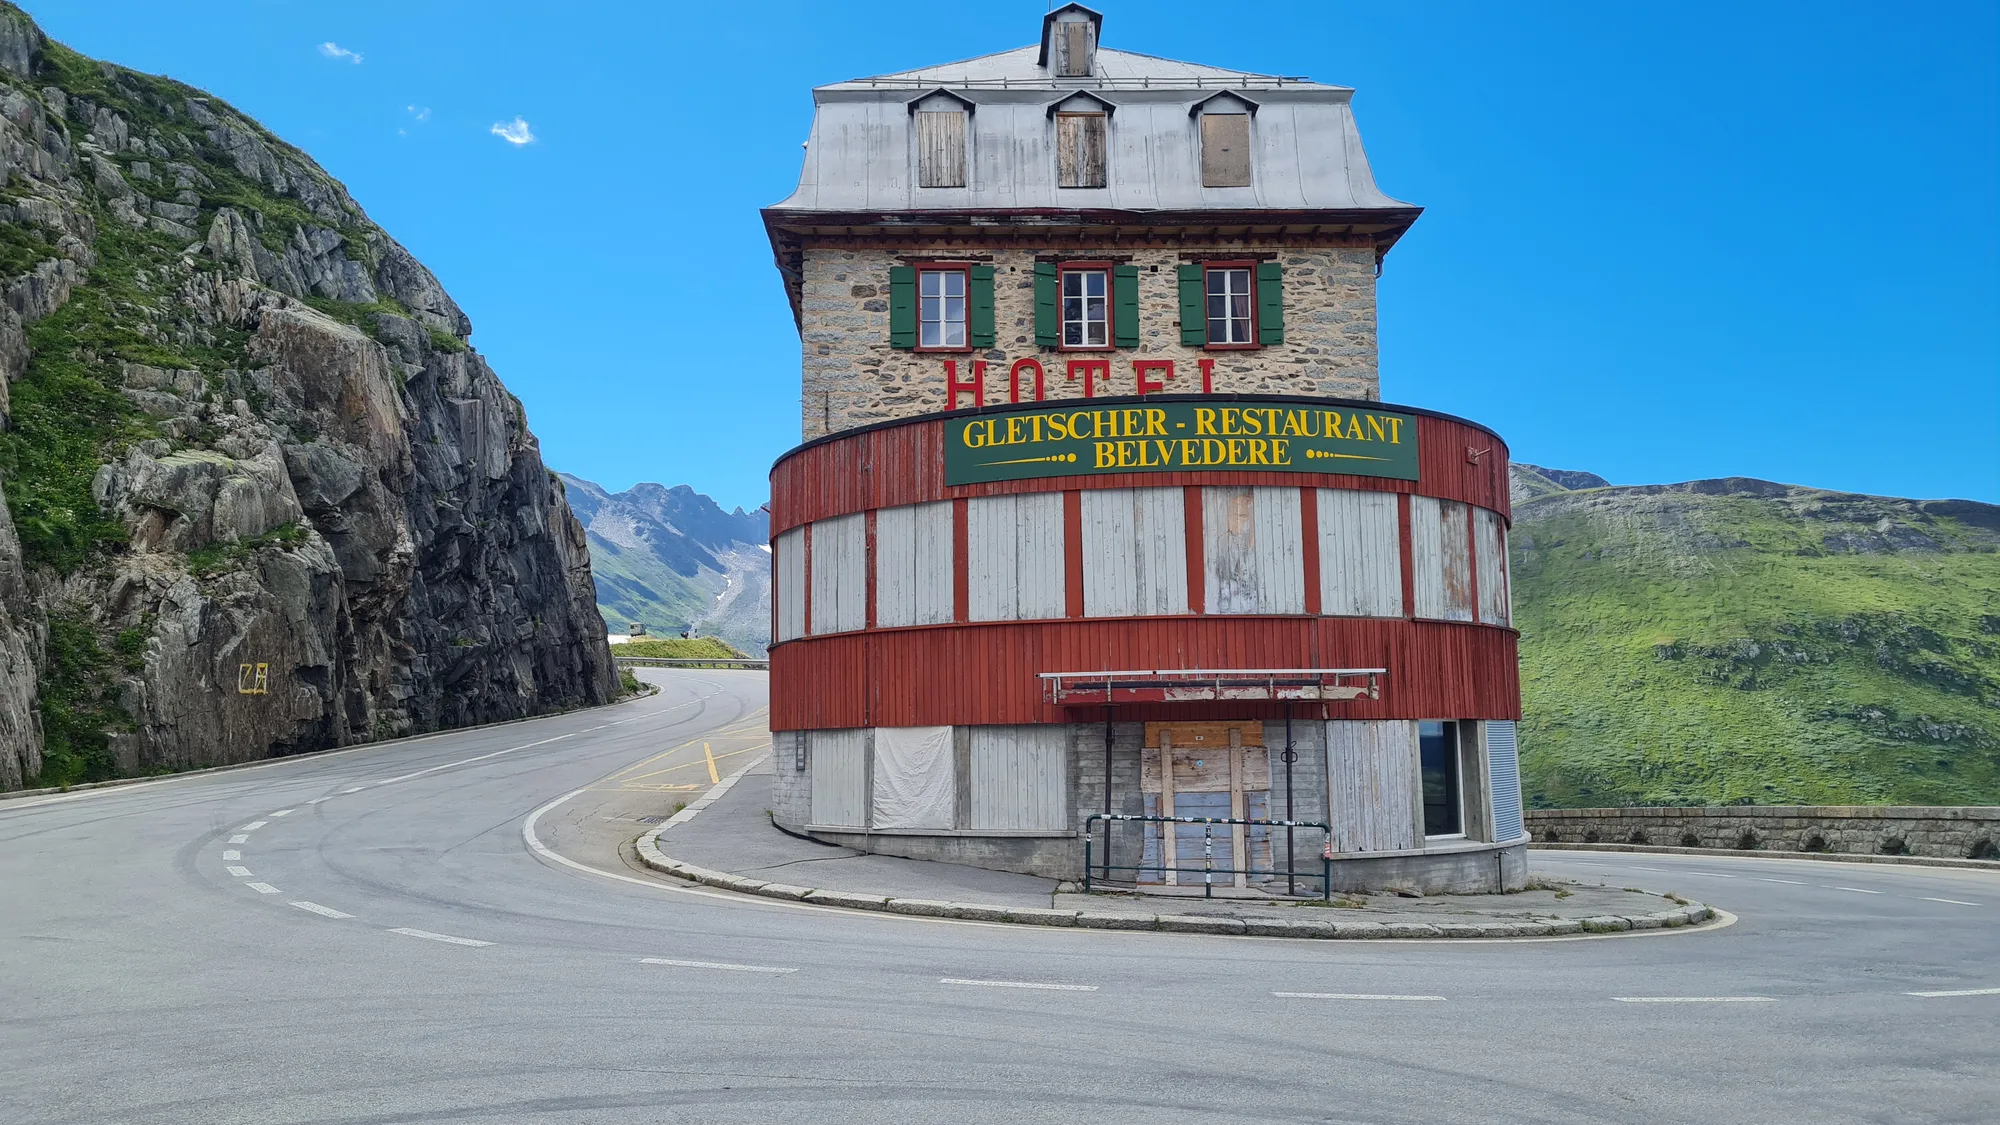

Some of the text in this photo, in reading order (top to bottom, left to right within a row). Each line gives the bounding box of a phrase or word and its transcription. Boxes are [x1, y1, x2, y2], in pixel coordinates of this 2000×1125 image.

[963, 408, 1168, 448] GLETSCHER
[1194, 408, 1403, 444] RESTAURANT
[1093, 438, 1292, 469] BELVEDERE
